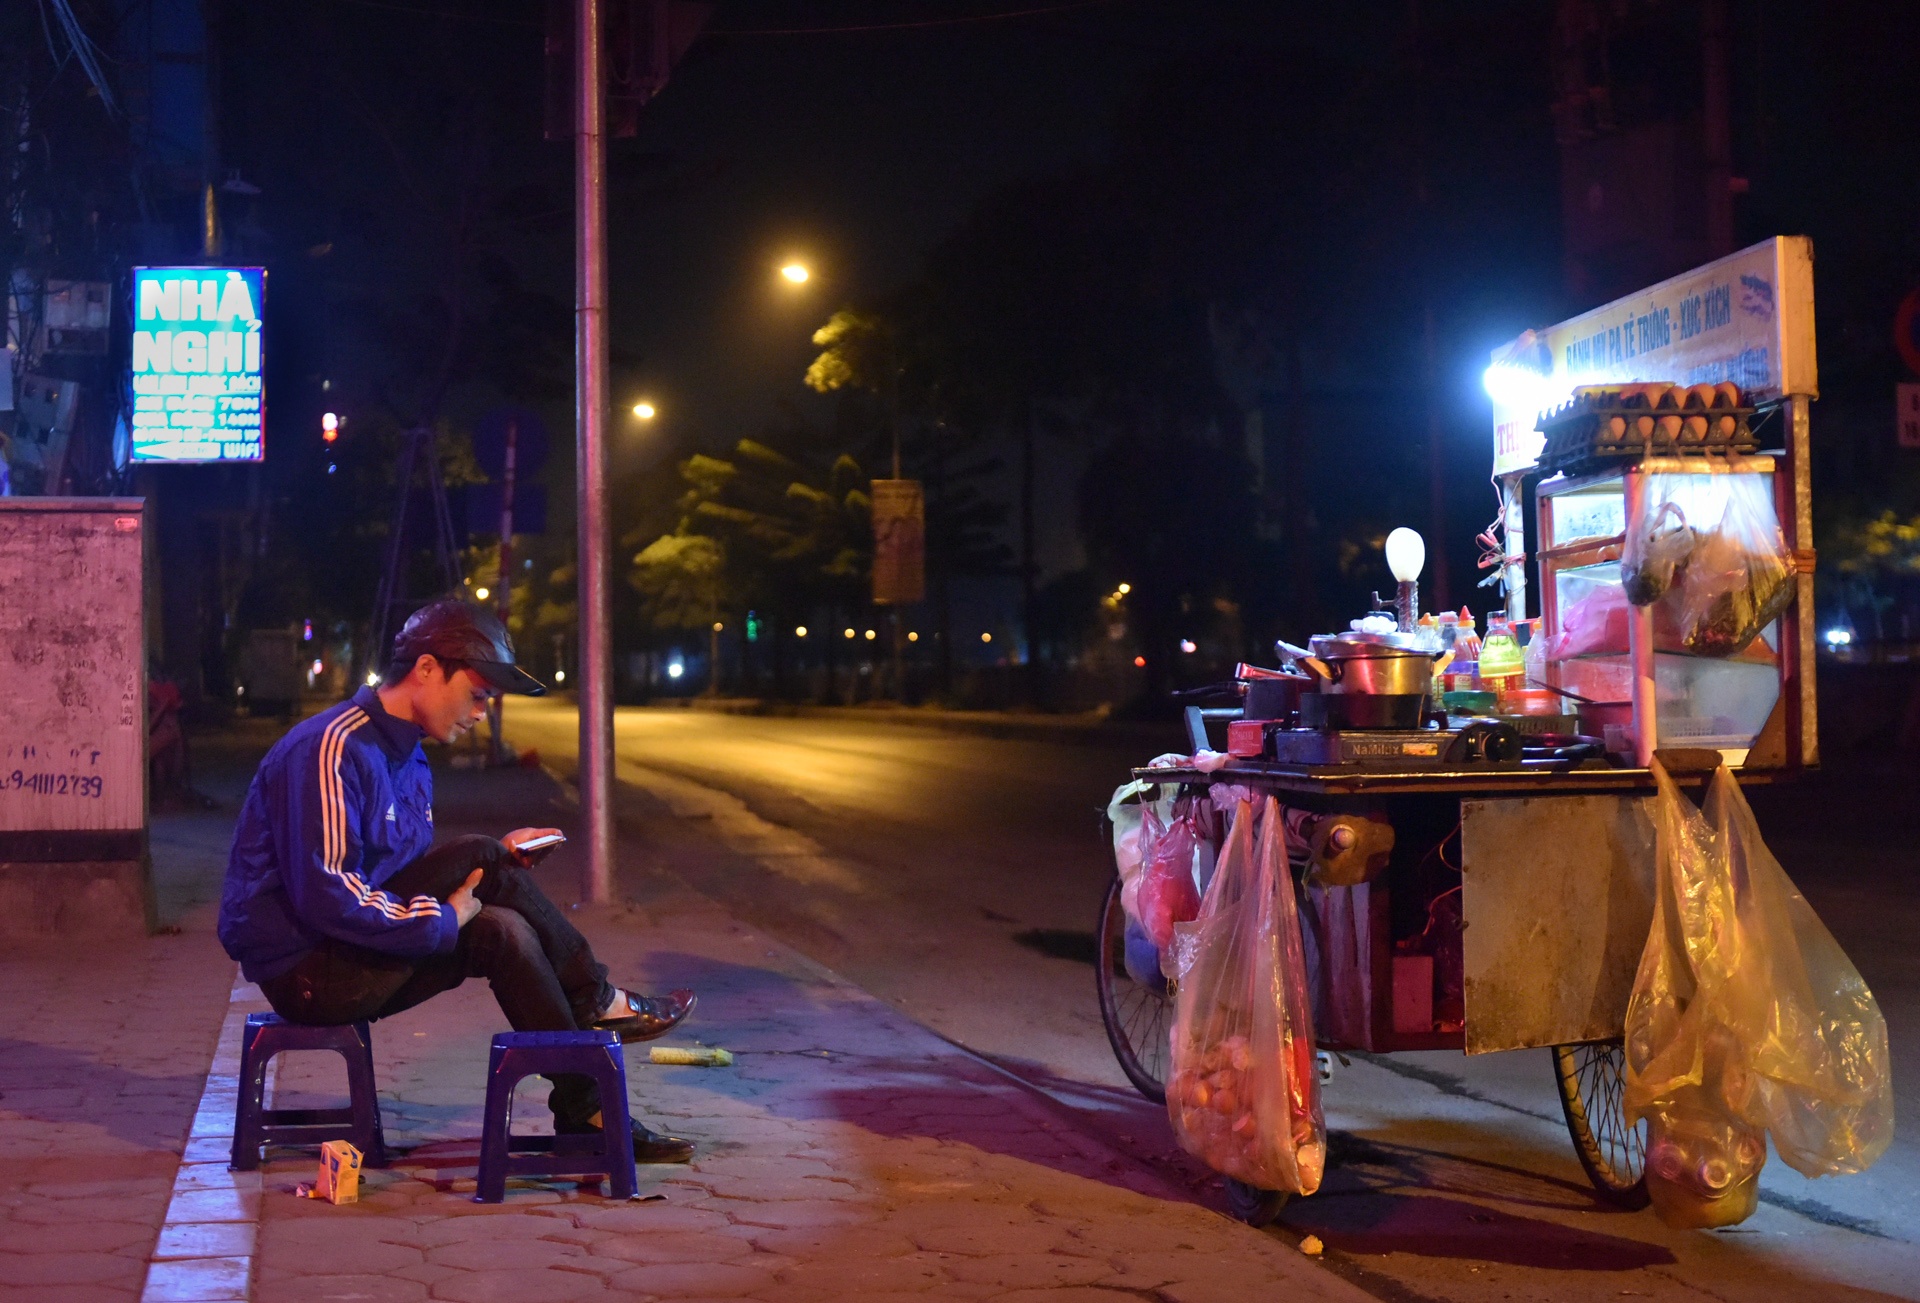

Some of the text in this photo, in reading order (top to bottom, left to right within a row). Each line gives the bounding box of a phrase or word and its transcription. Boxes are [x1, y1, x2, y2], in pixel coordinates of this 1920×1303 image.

[140, 271, 256, 321] NHÀ
[132, 319, 262, 373] NGHỈ
[1608, 326, 1622, 365] PA
